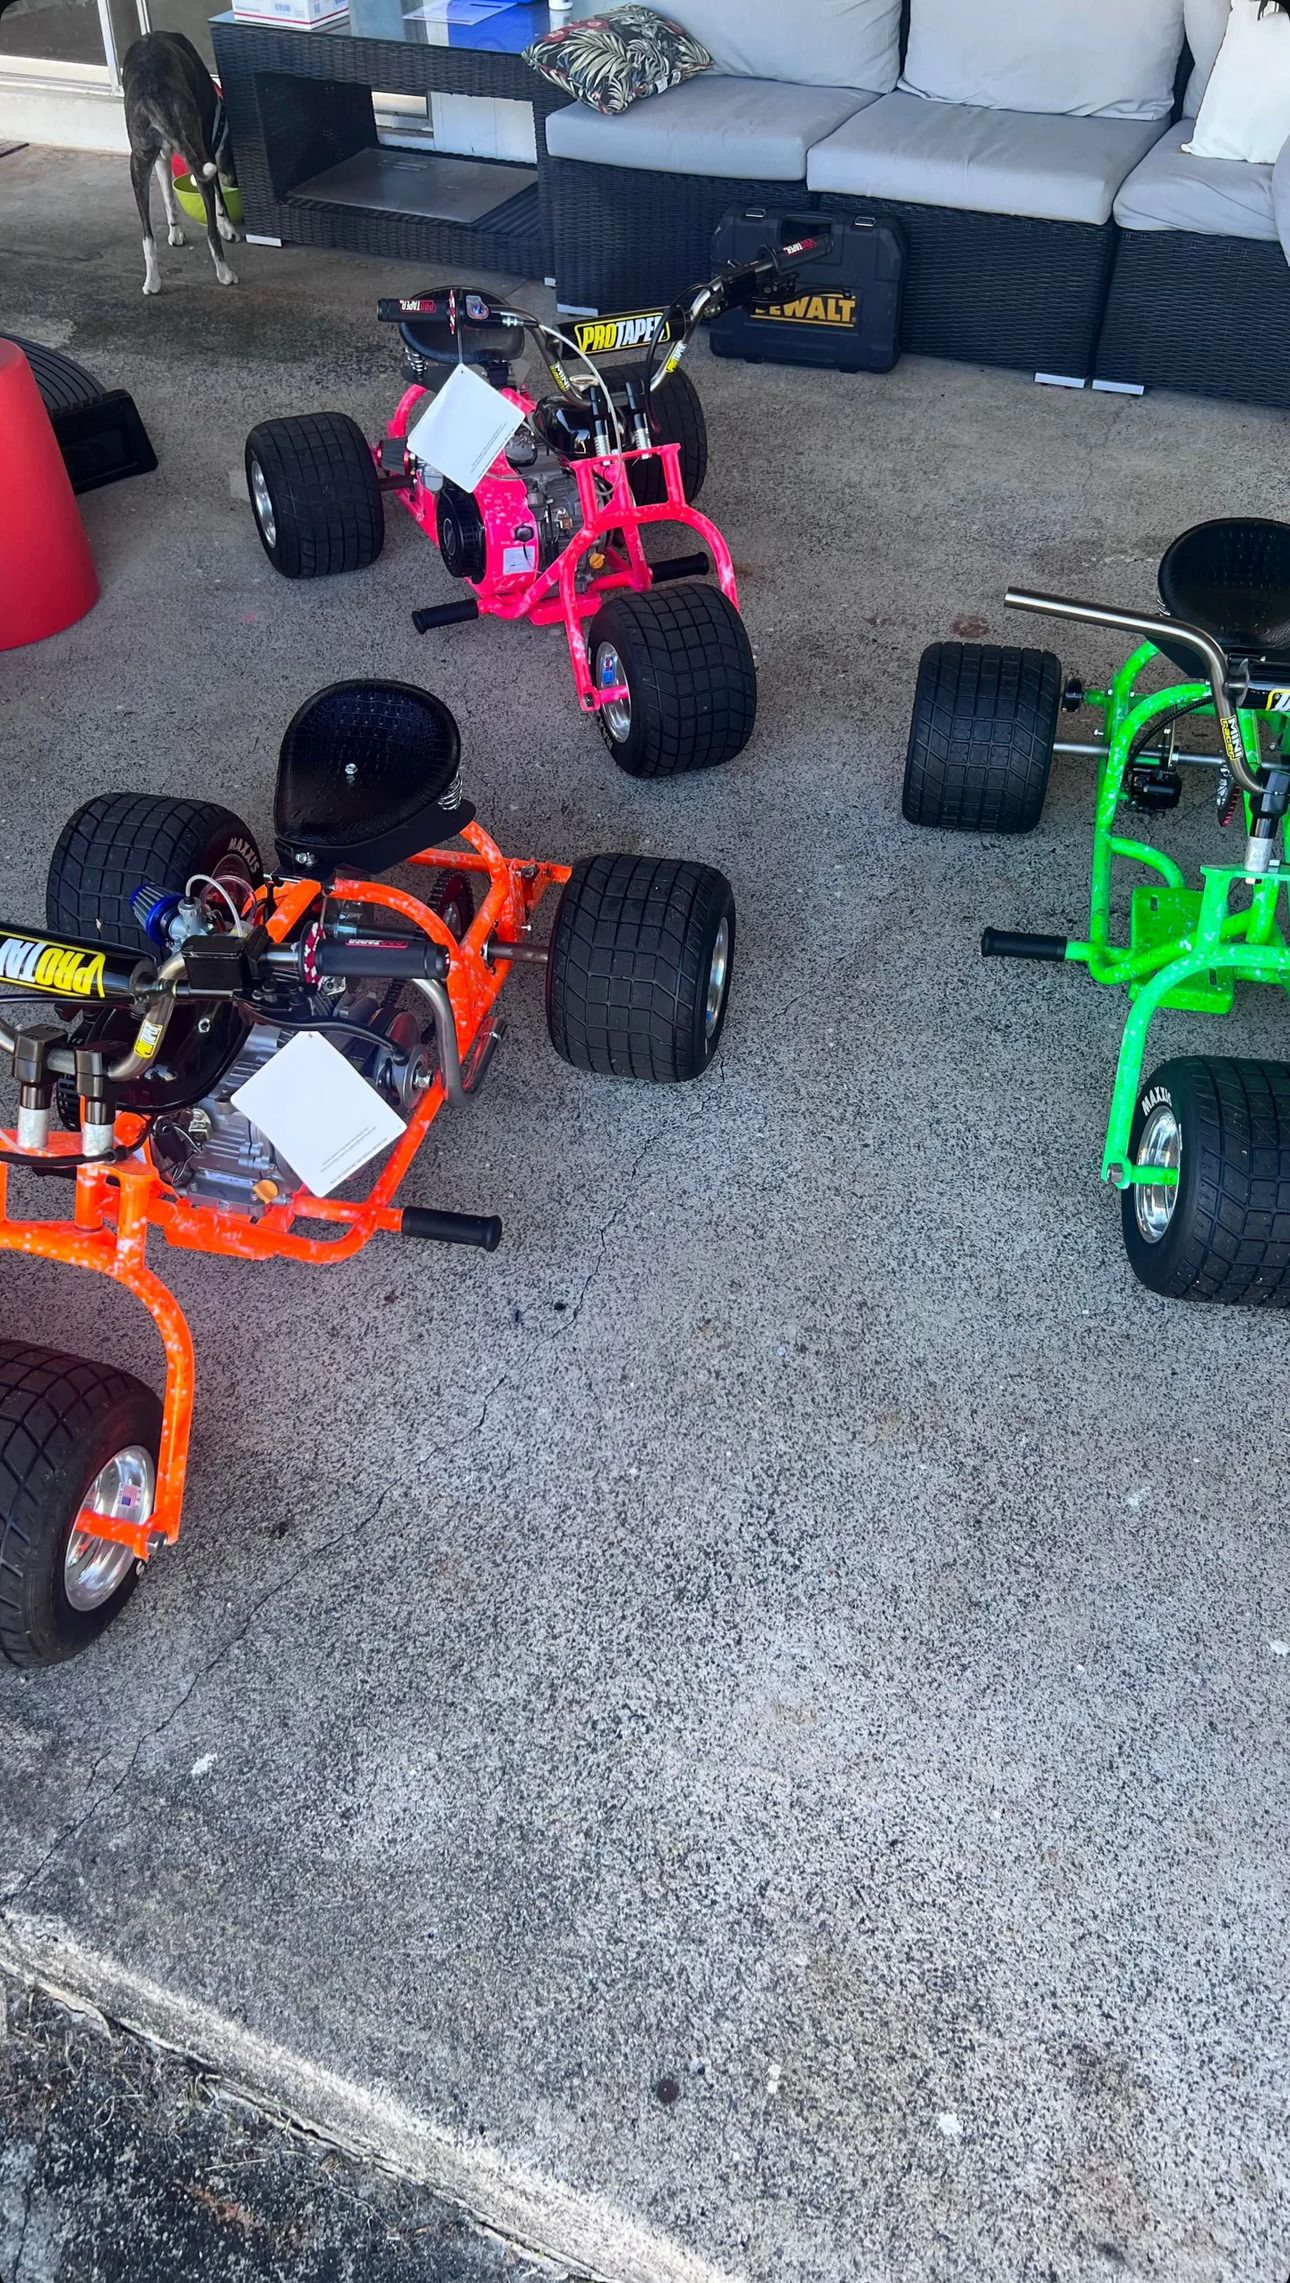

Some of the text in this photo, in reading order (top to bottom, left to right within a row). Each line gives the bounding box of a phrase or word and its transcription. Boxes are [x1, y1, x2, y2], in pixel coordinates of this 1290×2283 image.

[755, 295, 856, 322] WALT
[1228, 717, 1243, 757] MINI
[226, 837, 260, 873] MAXXIS
